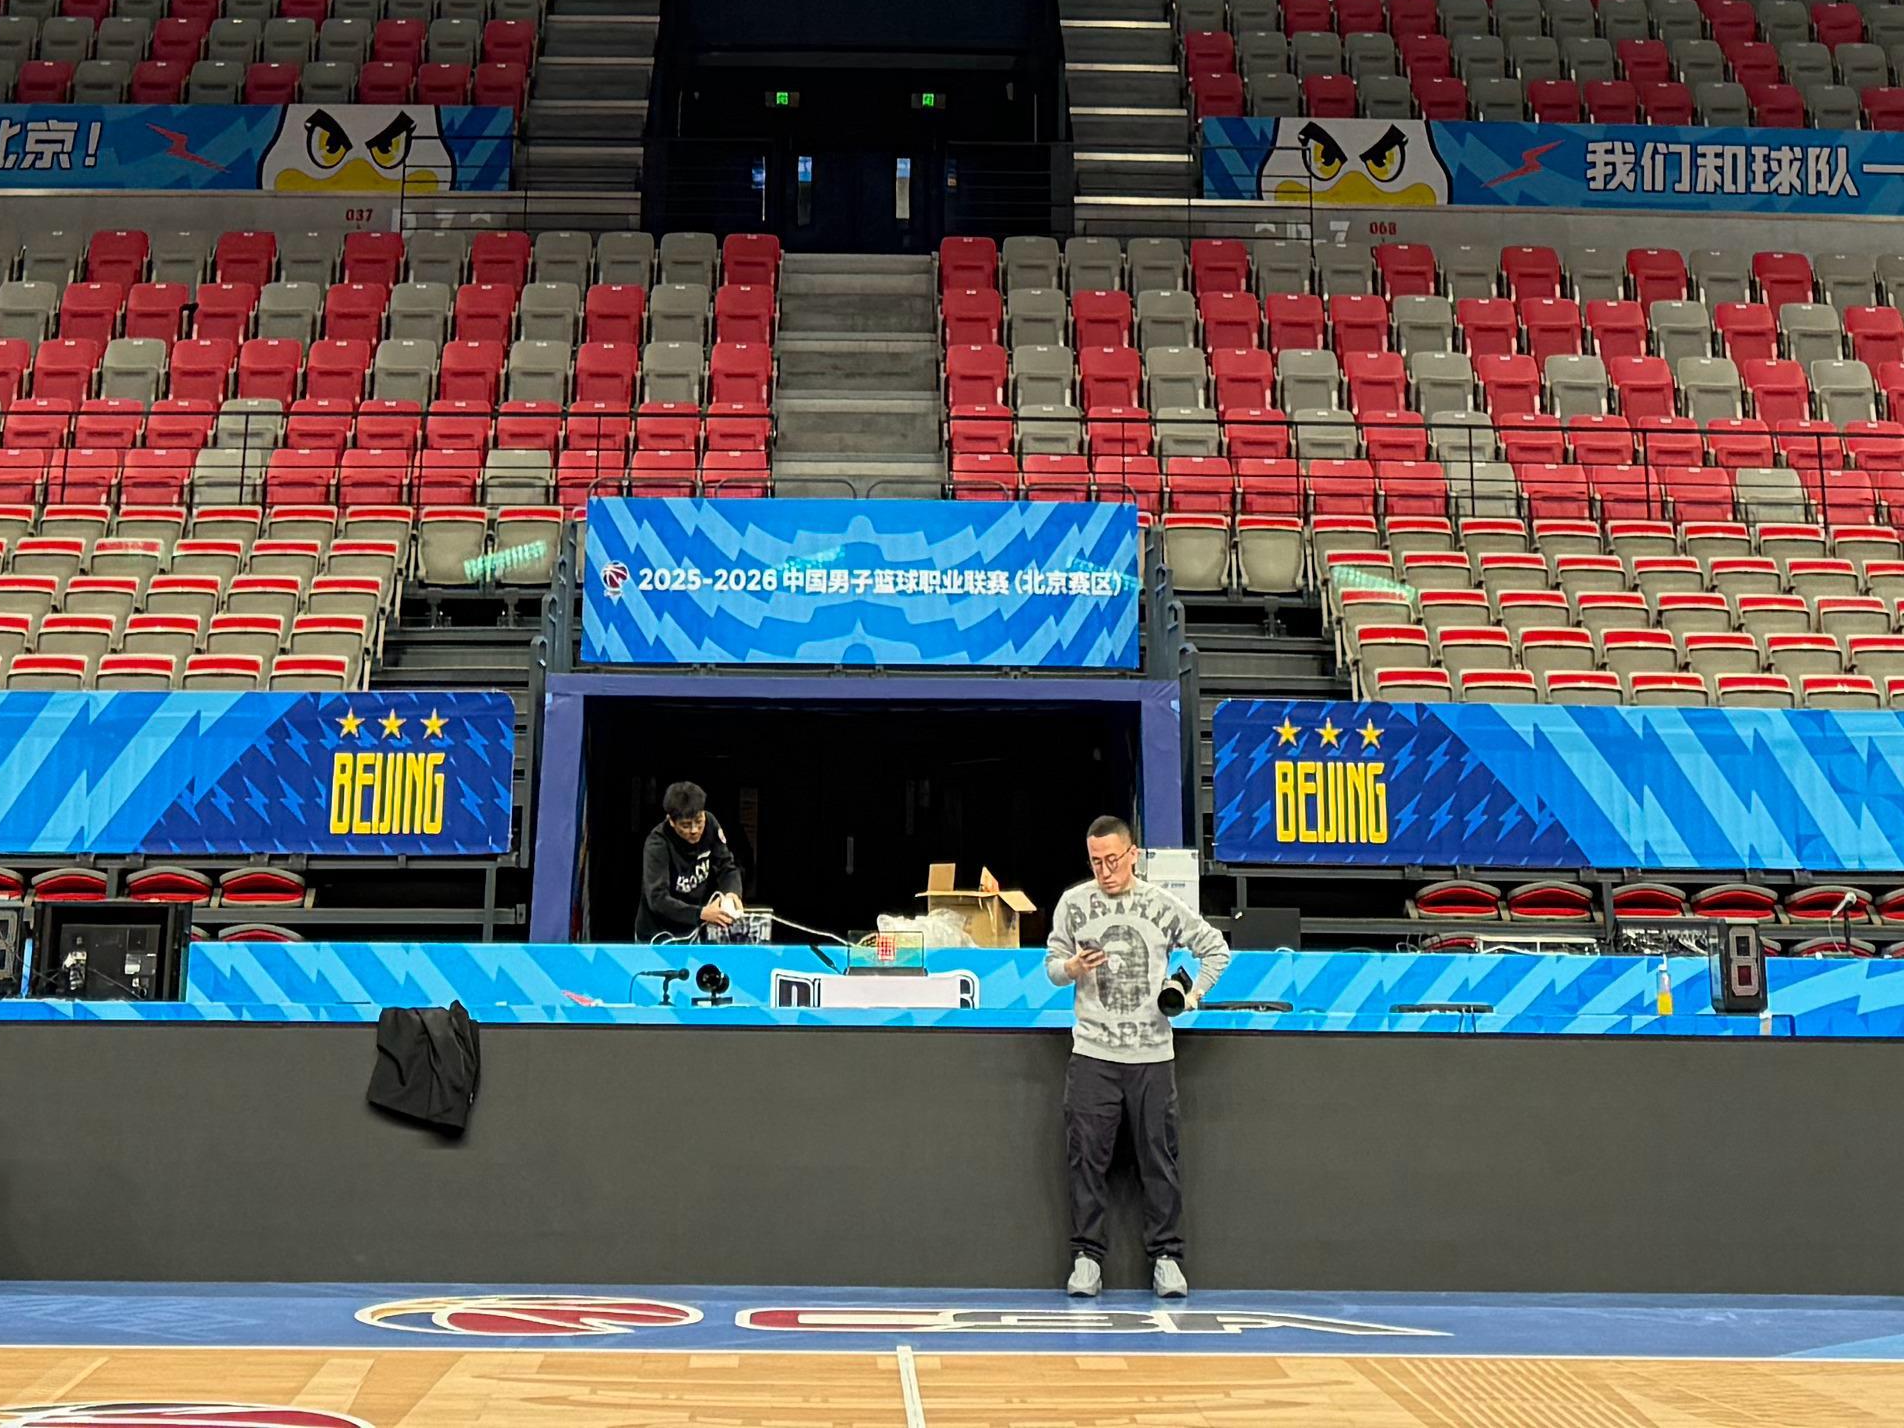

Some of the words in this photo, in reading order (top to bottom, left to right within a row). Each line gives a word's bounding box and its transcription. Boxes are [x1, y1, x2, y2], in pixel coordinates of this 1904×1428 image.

[639, 568, 777, 591] 2025-2026
[782, 567, 1008, 595] 中国男子篮球职业联赛
[329, 752, 445, 835] BEIJING
[1275, 760, 1388, 844] BEIJING
